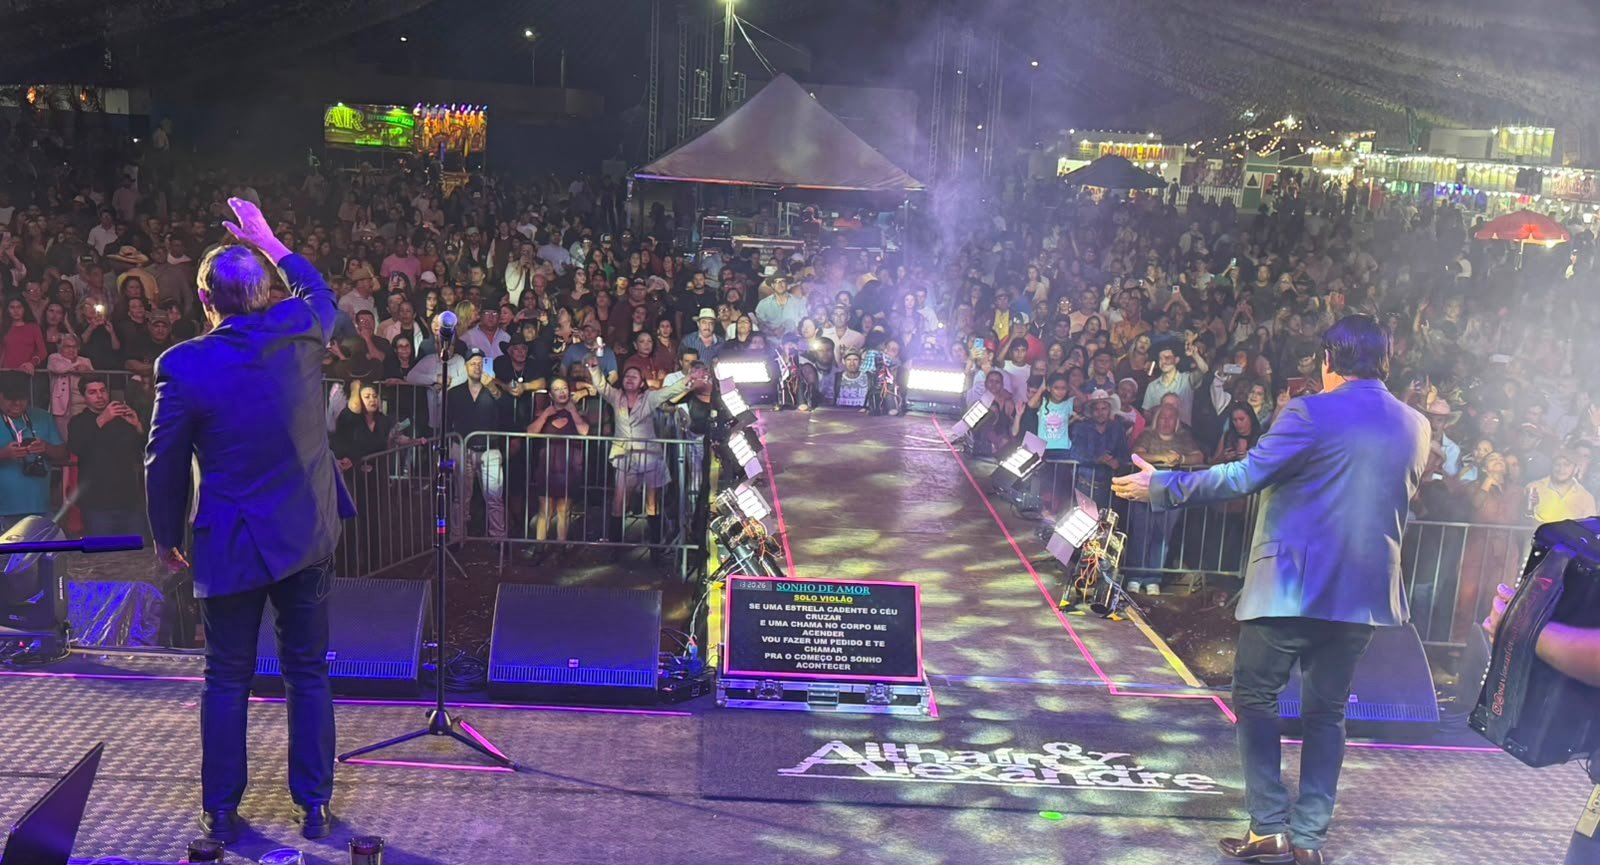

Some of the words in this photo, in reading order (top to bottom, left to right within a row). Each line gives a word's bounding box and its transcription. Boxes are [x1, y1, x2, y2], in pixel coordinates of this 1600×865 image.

[776, 582, 816, 592] SONHO
[818, 584, 833, 592] DE
[835, 585, 871, 594] AMOR
[820, 594, 853, 602] VIOLÃO
[763, 603, 783, 611] UMA
[785, 604, 825, 612] ESTRELA
[826, 606, 868, 614] CADENTE
[879, 607, 898, 615] CÉU
[805, 613, 842, 621] CRUZAR
[794, 654, 833, 662] COMEÇO
[796, 662, 851, 670] ACONTECER
[1042, 741, 1131, 770] &
